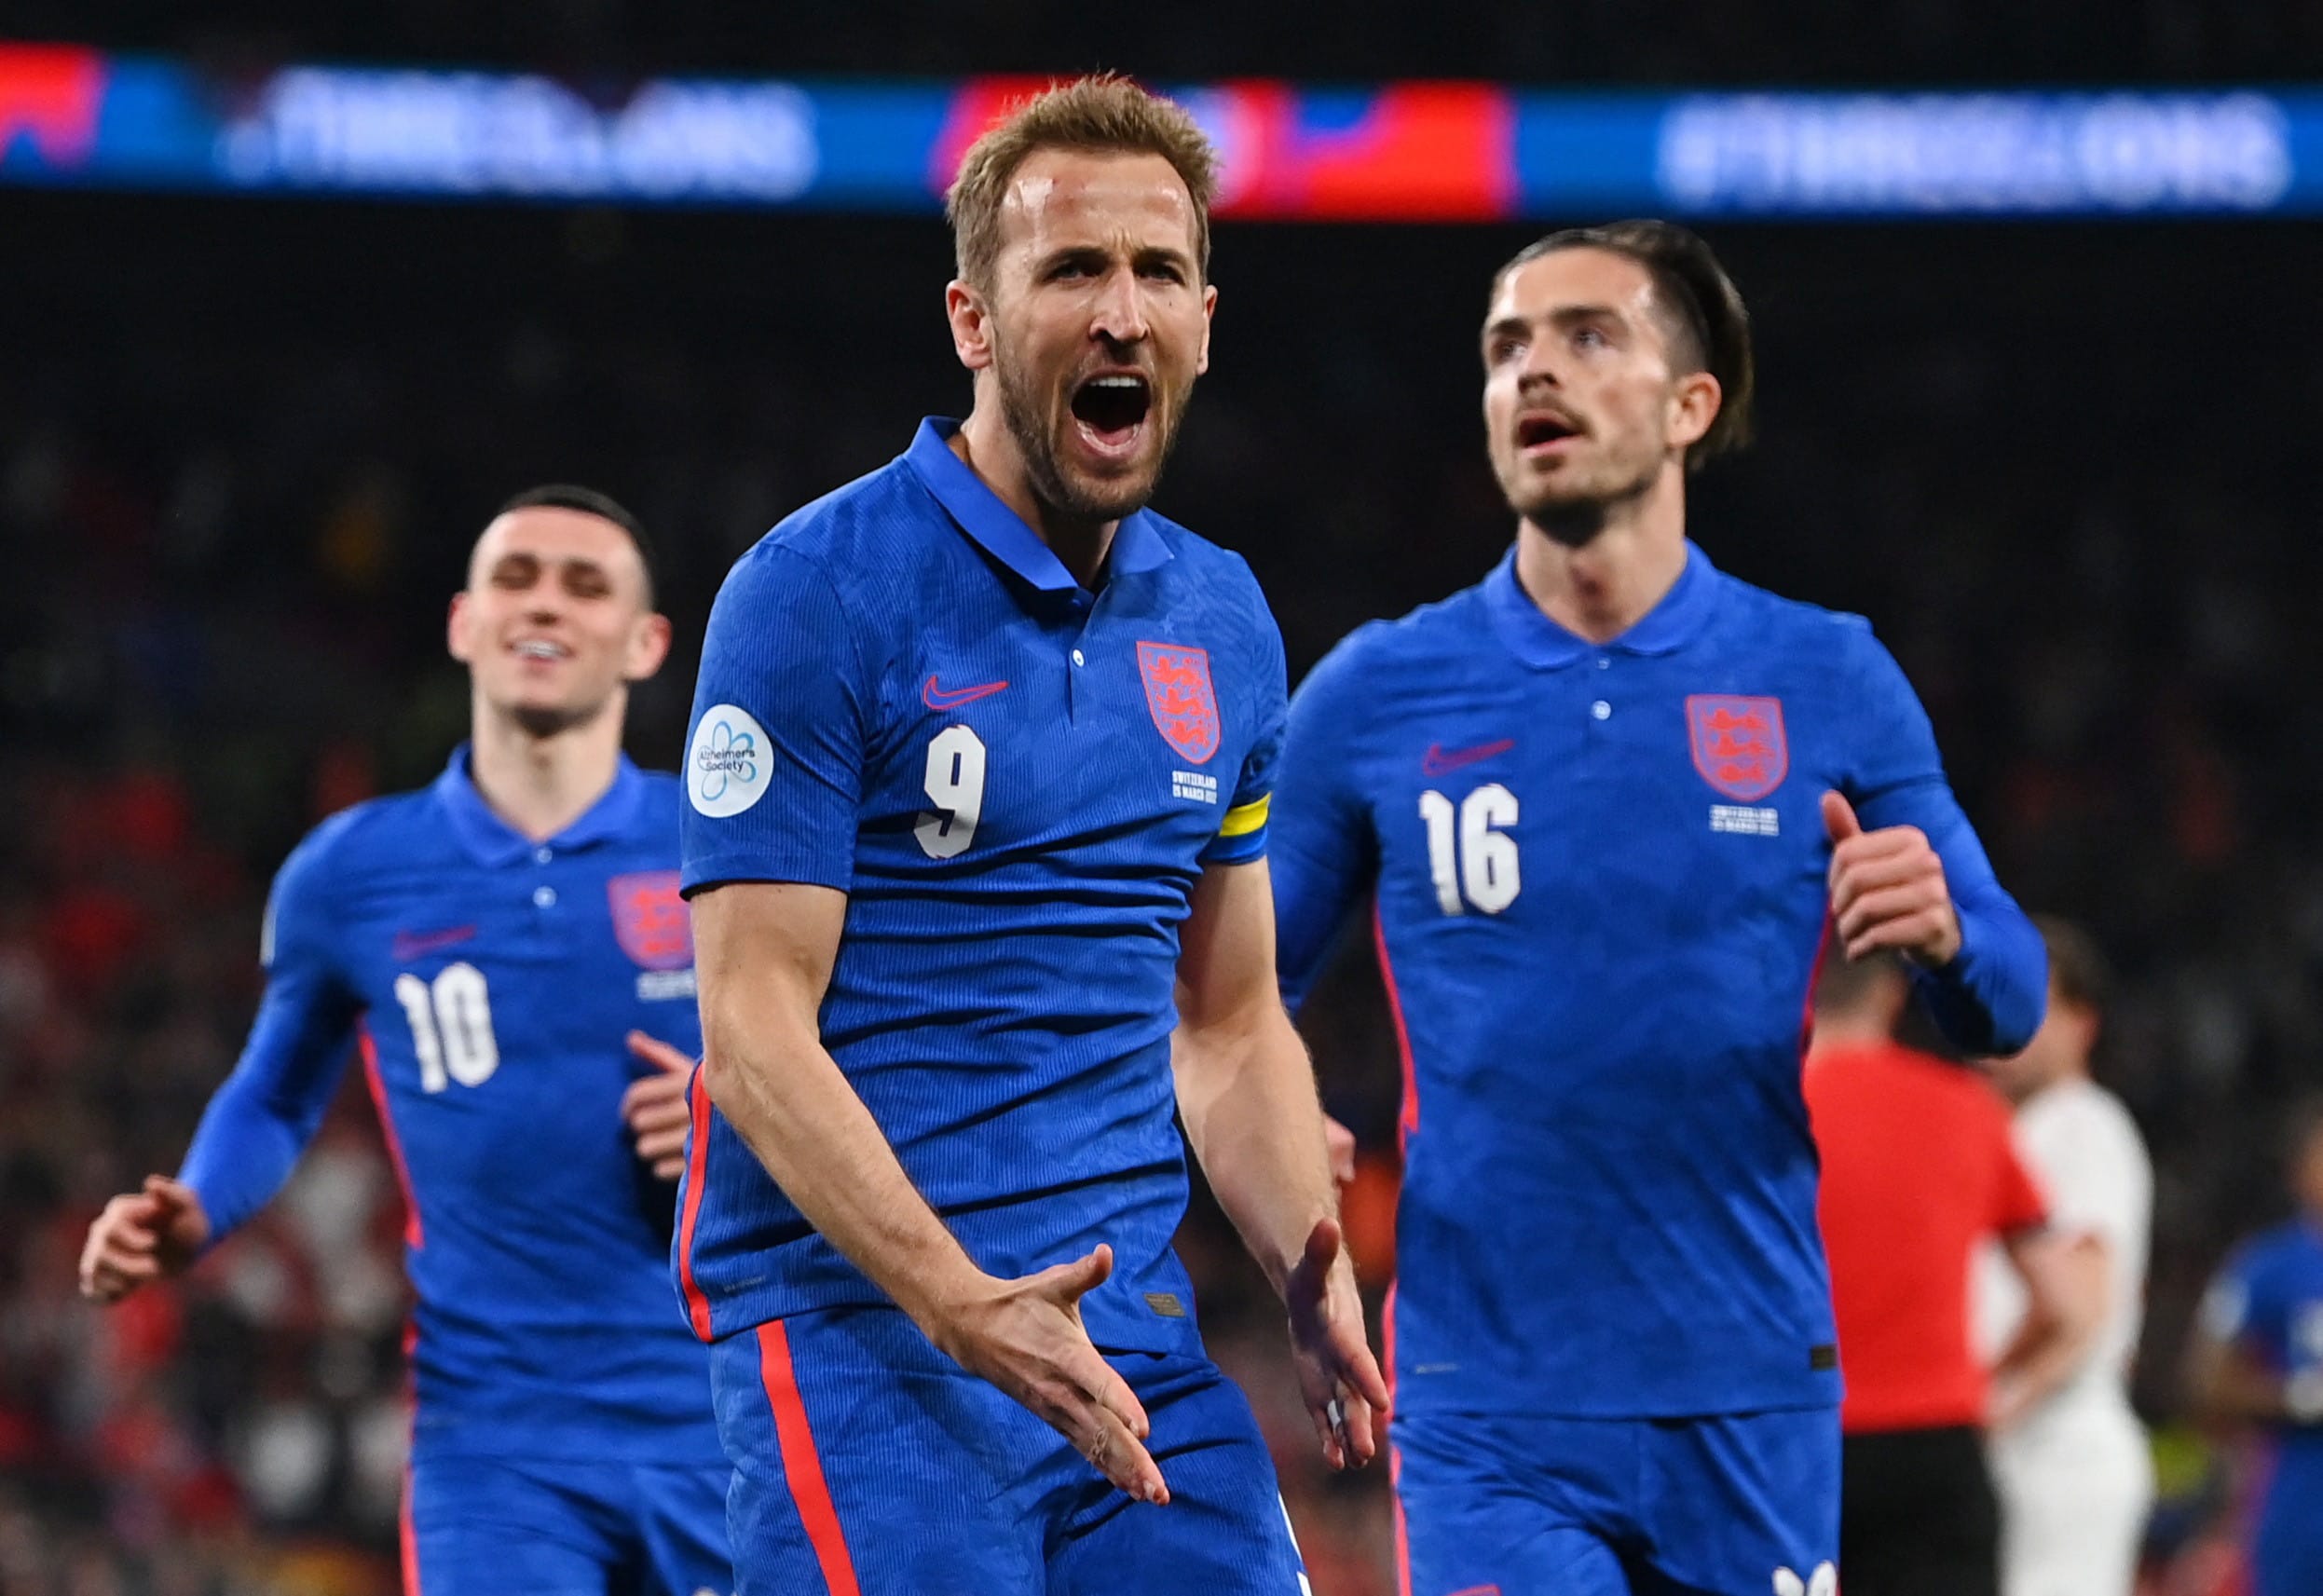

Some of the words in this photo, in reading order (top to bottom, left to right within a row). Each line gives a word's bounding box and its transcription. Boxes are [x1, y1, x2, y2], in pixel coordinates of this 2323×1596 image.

[706, 760, 744, 773] Society
[913, 723, 986, 859] 9
[1418, 783, 1521, 917] 16
[394, 962, 500, 1094] 10
